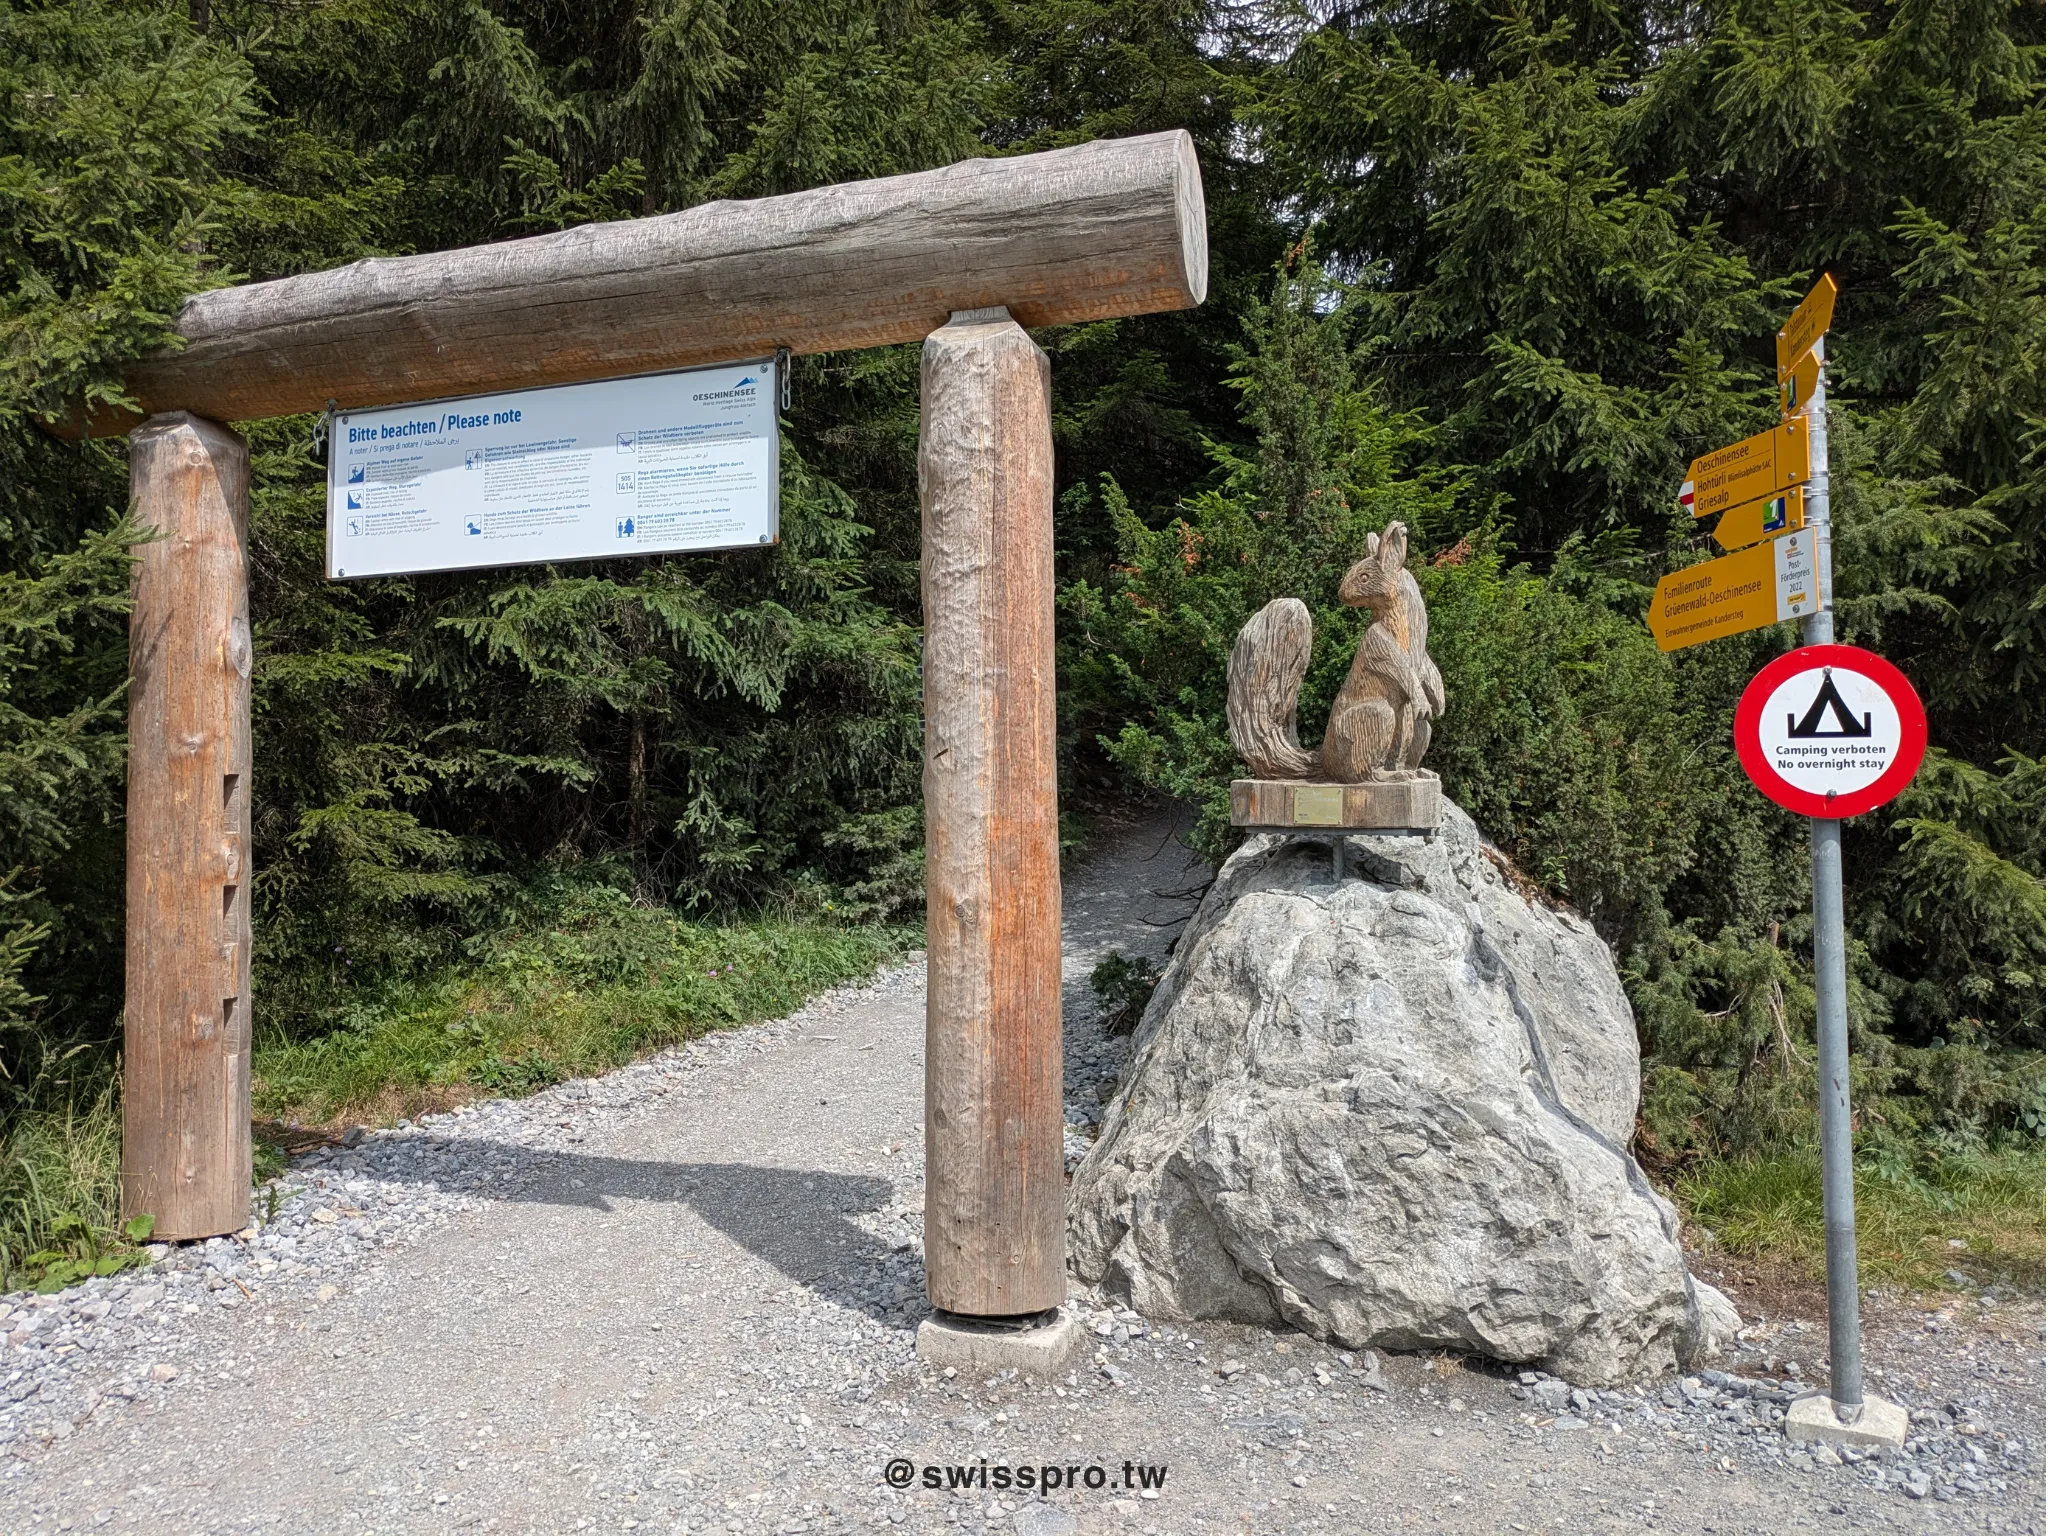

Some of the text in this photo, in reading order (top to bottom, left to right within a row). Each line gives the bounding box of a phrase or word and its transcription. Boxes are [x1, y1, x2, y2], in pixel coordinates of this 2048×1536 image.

[693, 388, 756, 401] OESCHINENSEE
[349, 409, 522, 443] Bitte beachten / Please note
[354, 446, 368, 454] noter
[380, 443, 395, 453] prega
[402, 441, 418, 449] notare
[1698, 446, 1749, 473] Oeschinensee
[1698, 459, 1771, 493] Hohtürli Blümlisalphütte SAC
[618, 482, 634, 491] 1414
[1698, 490, 1729, 510] Griesalp
[1770, 499, 1778, 518] 1
[1788, 561, 1801, 570] Post-
[1781, 567, 1810, 583] Förderpreis
[1789, 581, 1802, 593] 2022
[1665, 580, 1762, 617] Grüenewald-Oeschinensee
[1665, 610, 1743, 638] Einwohnergemeinde Kandersteg
[1776, 744, 1886, 757] Camping verboten
[1778, 759, 1885, 770] No overnight stay
